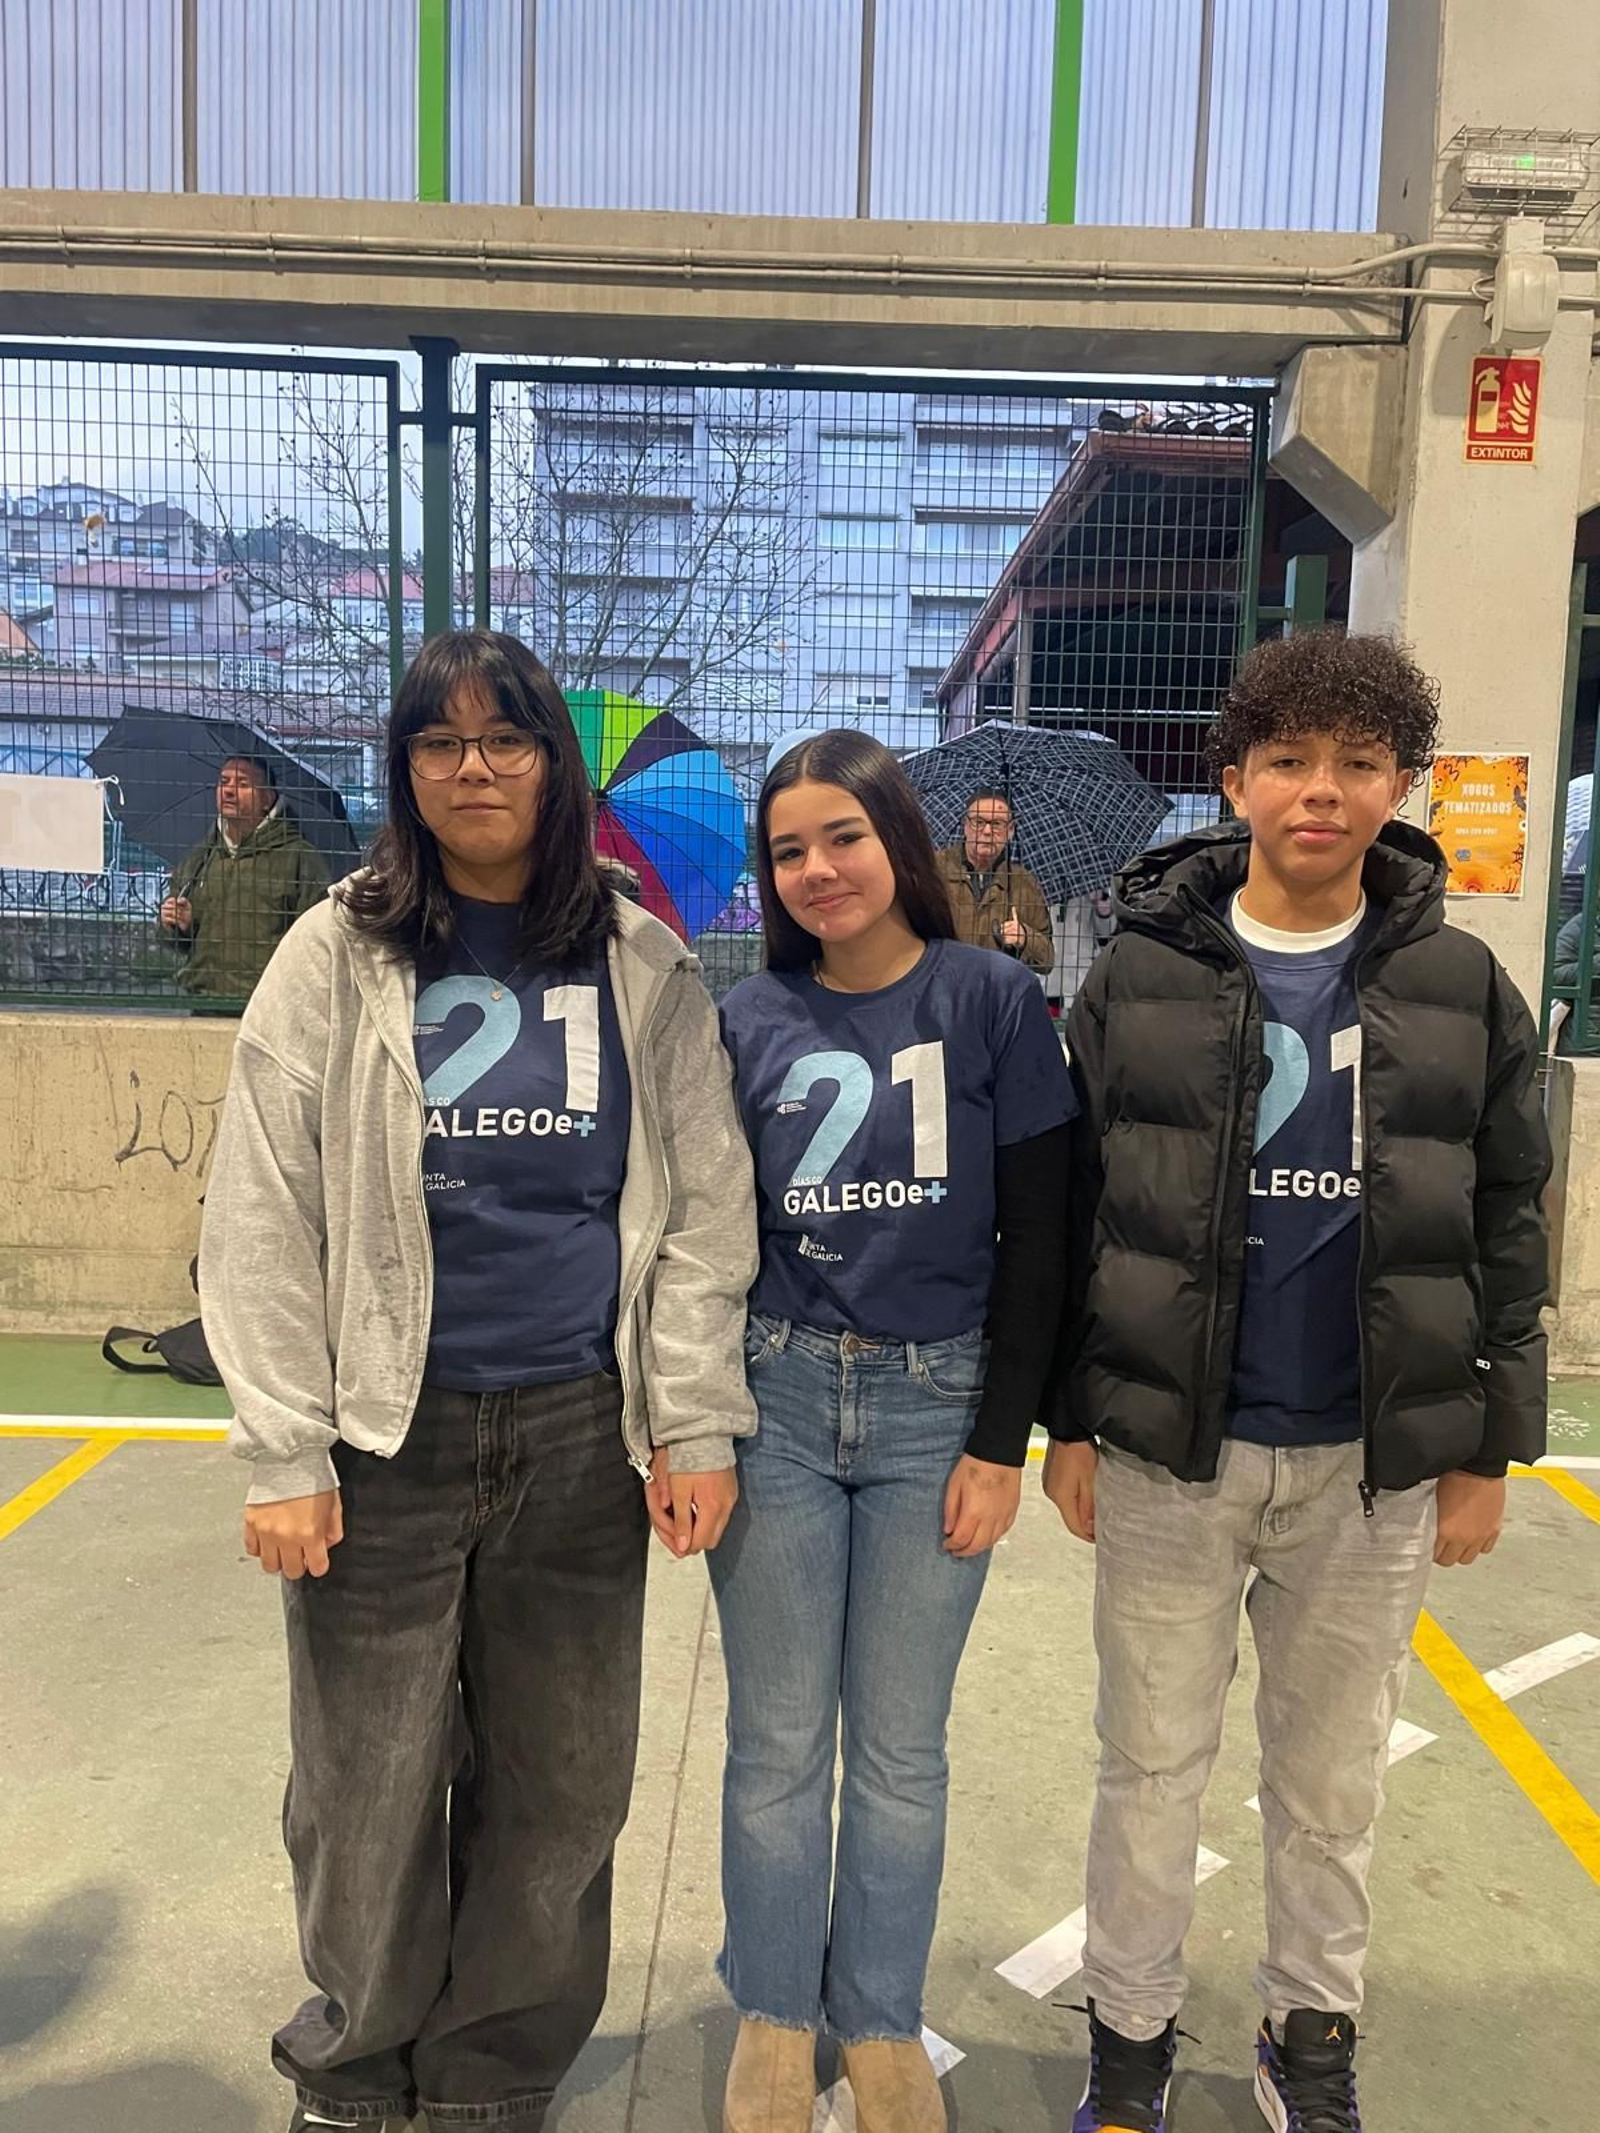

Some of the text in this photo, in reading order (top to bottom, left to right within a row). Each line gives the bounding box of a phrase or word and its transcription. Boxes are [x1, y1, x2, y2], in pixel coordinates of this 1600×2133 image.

[1471, 447, 1528, 459] EXTINTOR
[1461, 783, 1495, 797] XOGOS
[1444, 801, 1513, 815] TEMATIZADOS
[415, 974, 599, 1113] 21
[777, 1040, 948, 1188] 21
[424, 1108, 597, 1138] ALEGOe+
[425, 1179, 466, 1191] GALICIA
[1248, 1168, 1361, 1200] LEGOe
[811, 1251, 844, 1262] GALICIA
